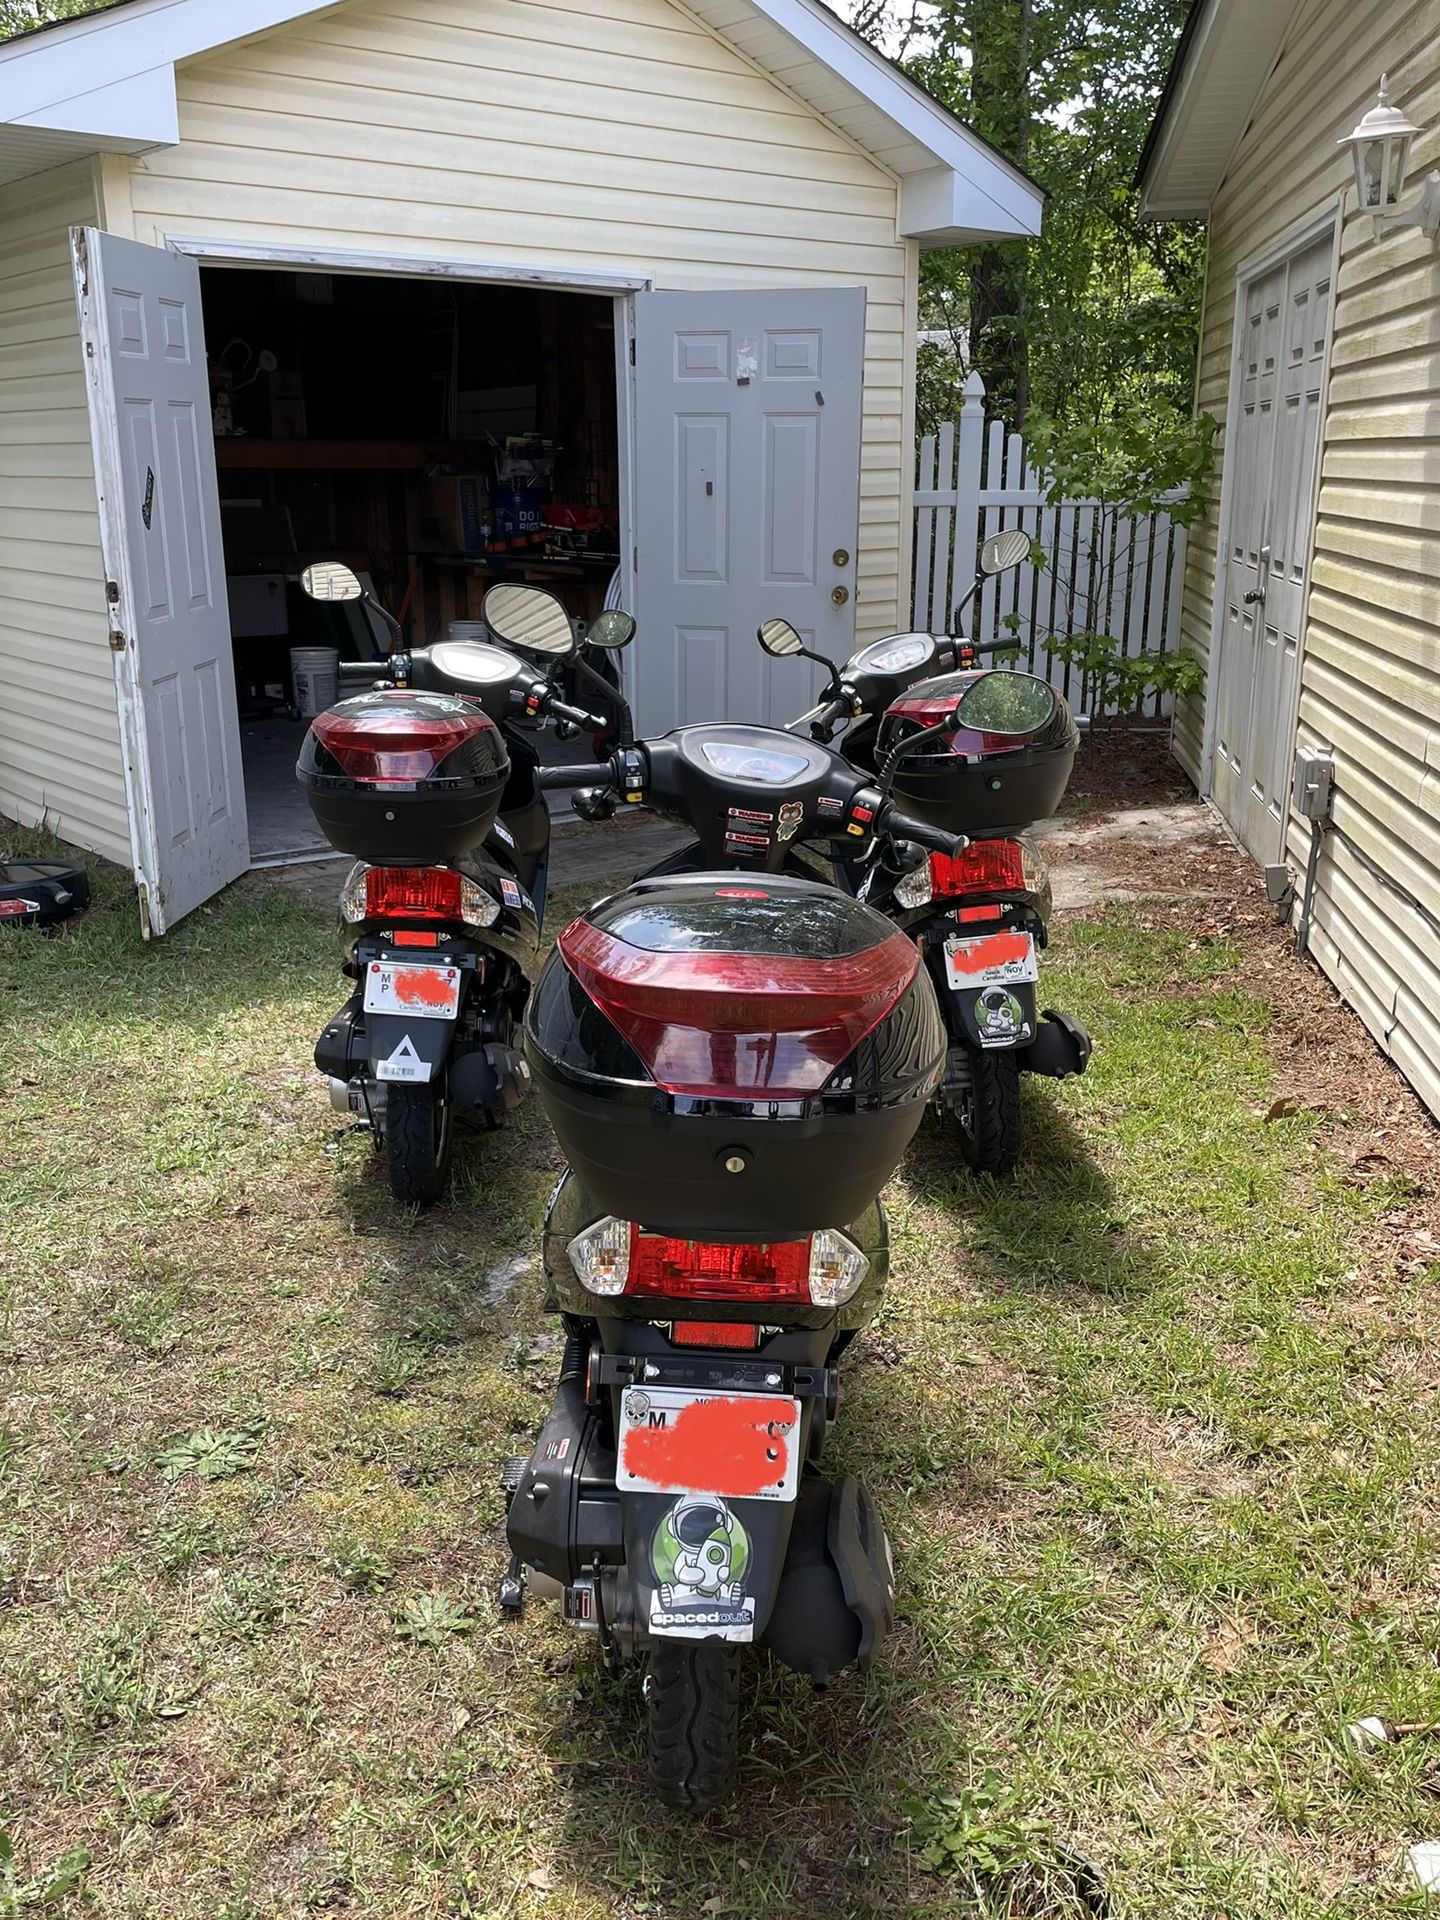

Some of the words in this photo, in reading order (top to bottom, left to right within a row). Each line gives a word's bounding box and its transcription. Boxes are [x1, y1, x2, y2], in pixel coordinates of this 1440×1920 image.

[1007, 965, 1023, 974] NOV
[381, 974, 391, 983] M
[381, 984, 389, 993] P
[648, 1411, 666, 1430] M
[651, 1610, 751, 1627] spacedout
